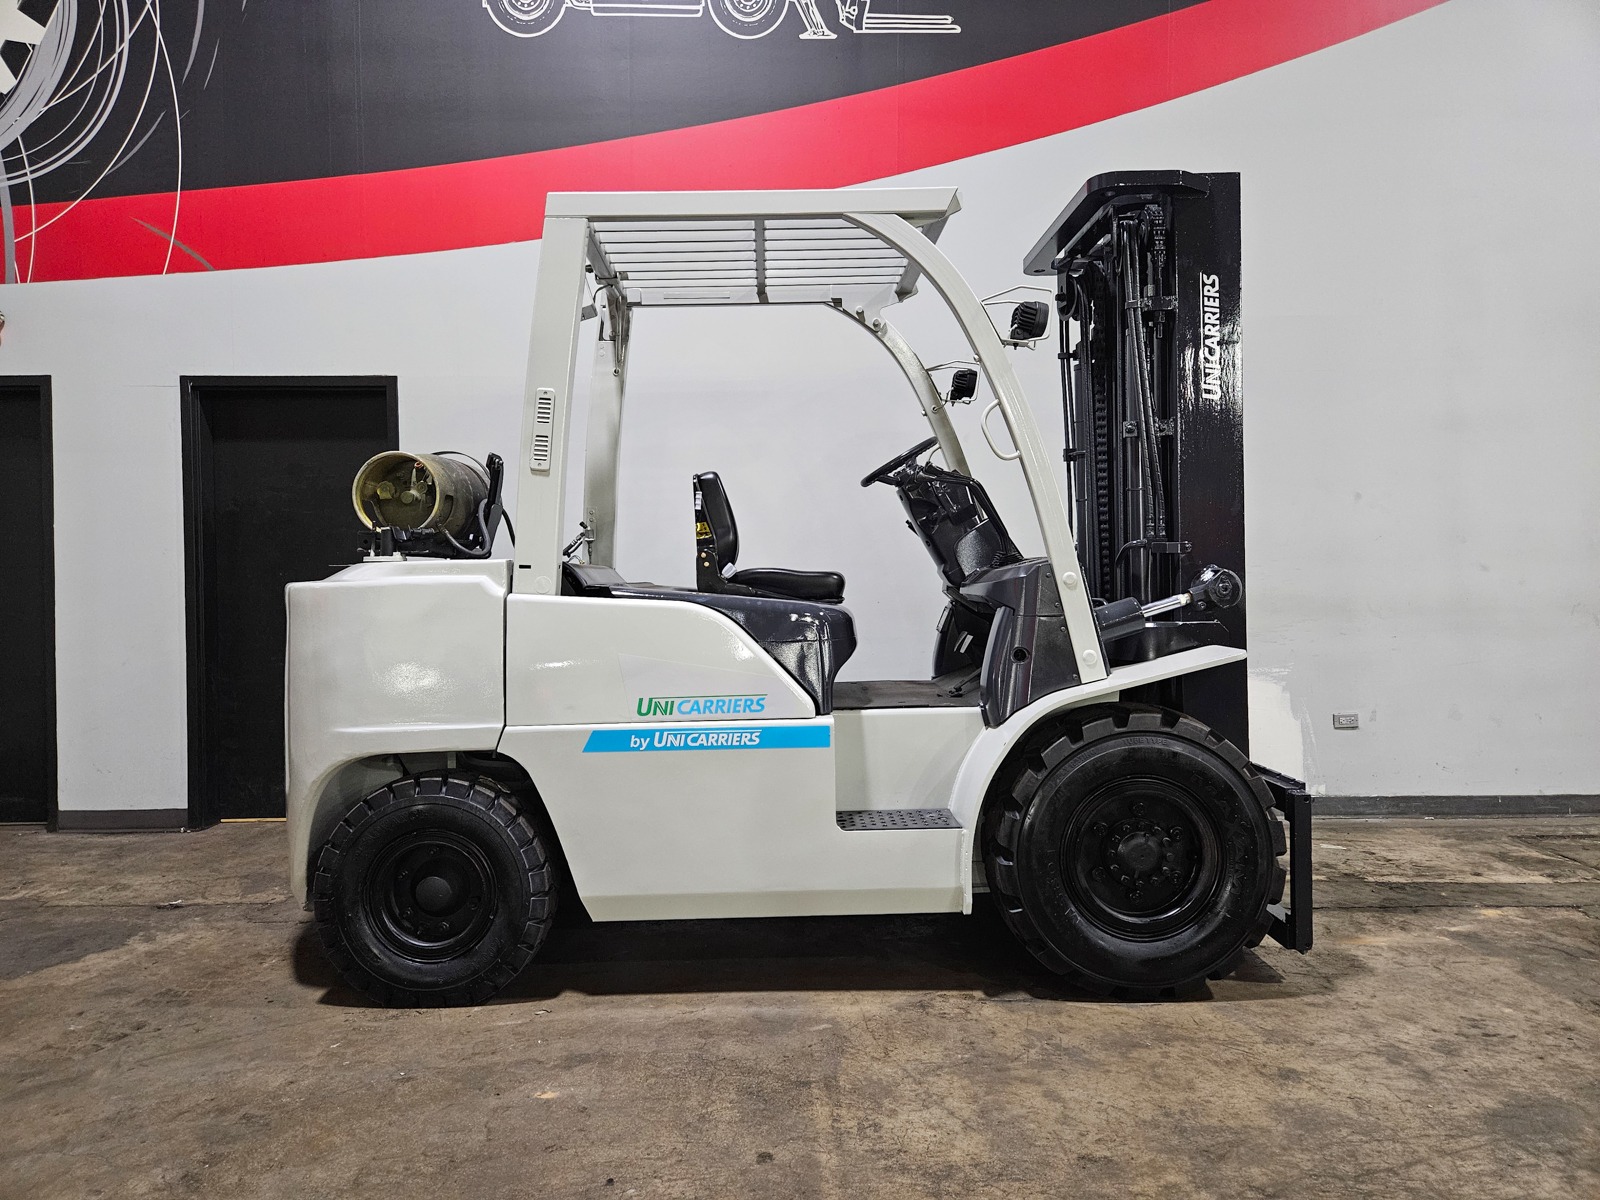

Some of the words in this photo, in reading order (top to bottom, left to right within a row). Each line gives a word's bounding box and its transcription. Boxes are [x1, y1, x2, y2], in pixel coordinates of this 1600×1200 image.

[1200, 272, 1222, 400] UNICARRIERS
[630, 734, 651, 751] by
[653, 730, 762, 747] UNICARRIERS
